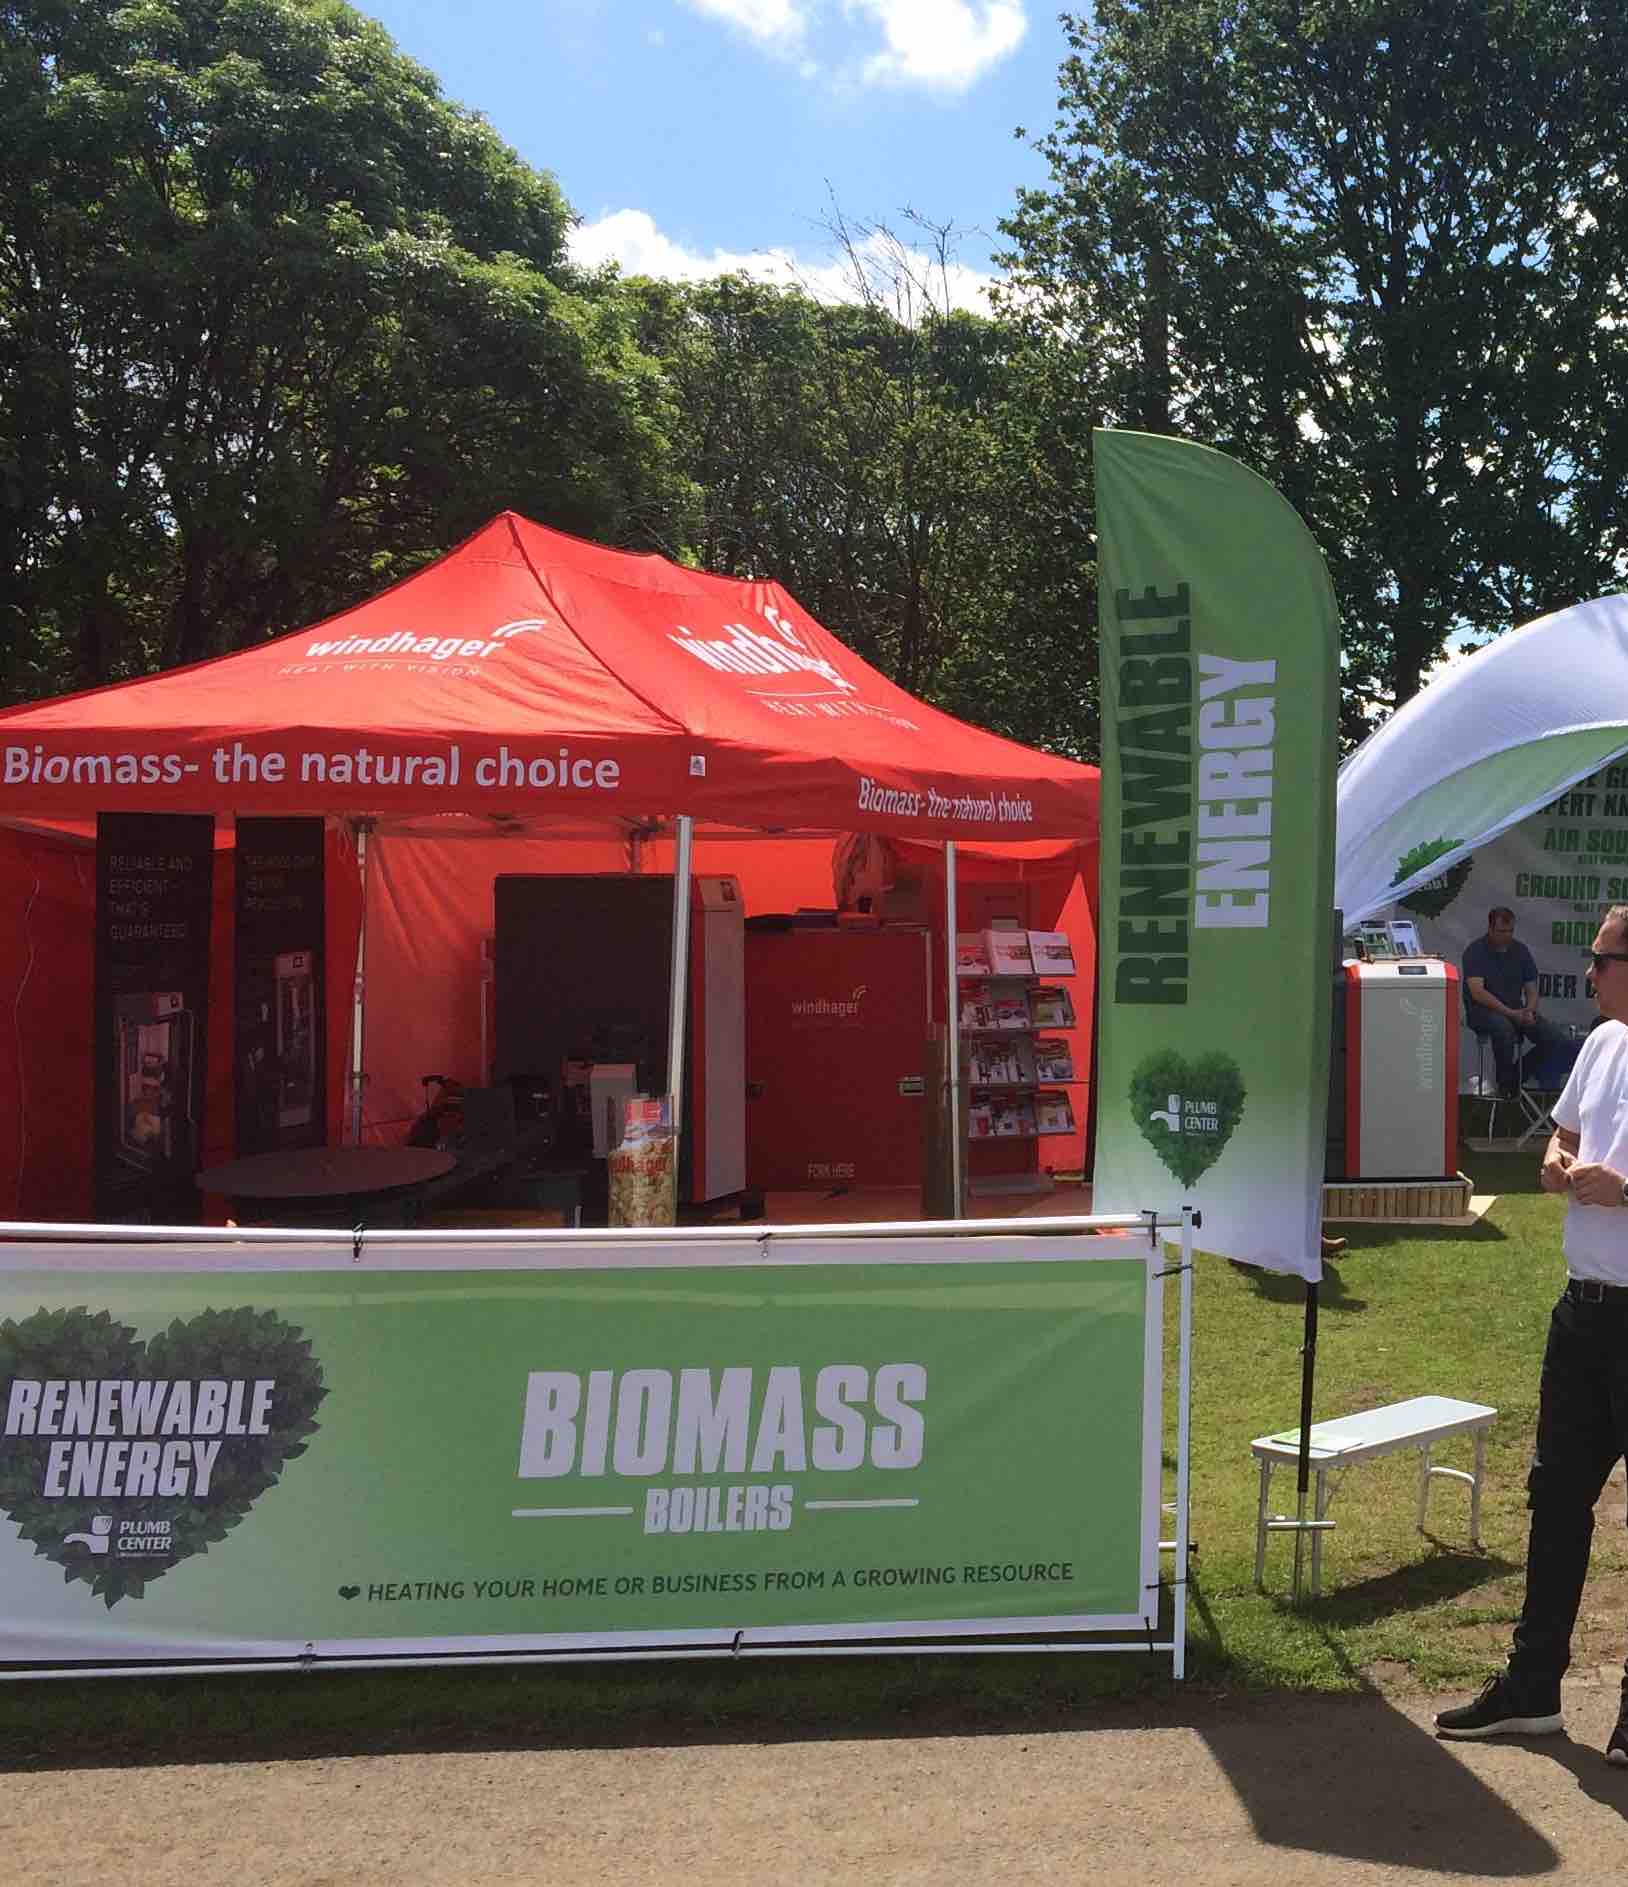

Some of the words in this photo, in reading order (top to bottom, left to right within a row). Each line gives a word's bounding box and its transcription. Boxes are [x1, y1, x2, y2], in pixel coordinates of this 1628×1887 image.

[305, 632, 504, 660] windhager
[211, 743, 286, 783] the
[301, 745, 459, 786] natural
[474, 746, 621, 789] choice
[927, 786, 951, 818] the
[952, 791, 996, 823] natural
[998, 791, 1033, 823] choice
[1114, 581, 1192, 1005] RENEWABLE
[1195, 654, 1277, 928] ENERGY
[1543, 827, 1579, 851] AIR
[1515, 872, 1601, 900] GROUND
[791, 998, 859, 1017] windhager
[1184, 1100, 1217, 1115] PLUMB
[1184, 1116, 1219, 1131] CENTER
[4, 1379, 275, 1436] RENEWABLE
[518, 1363, 928, 1479] BIOMASS
[42, 1441, 221, 1497] ENERGY
[119, 1519, 171, 1535] PLUMB
[643, 1485, 794, 1535] BOILERS
[117, 1536, 172, 1553] CENTER
[367, 1581, 466, 1601] HEATING
[473, 1578, 536, 1599] YOUR
[542, 1577, 607, 1597] HOME
[614, 1576, 644, 1595] OR
[652, 1572, 757, 1594] BUSINESS
[764, 1571, 825, 1592] FROM
[831, 1571, 847, 1588] A
[853, 1566, 957, 1587] GROWING
[963, 1563, 1073, 1584] RESOURCE
